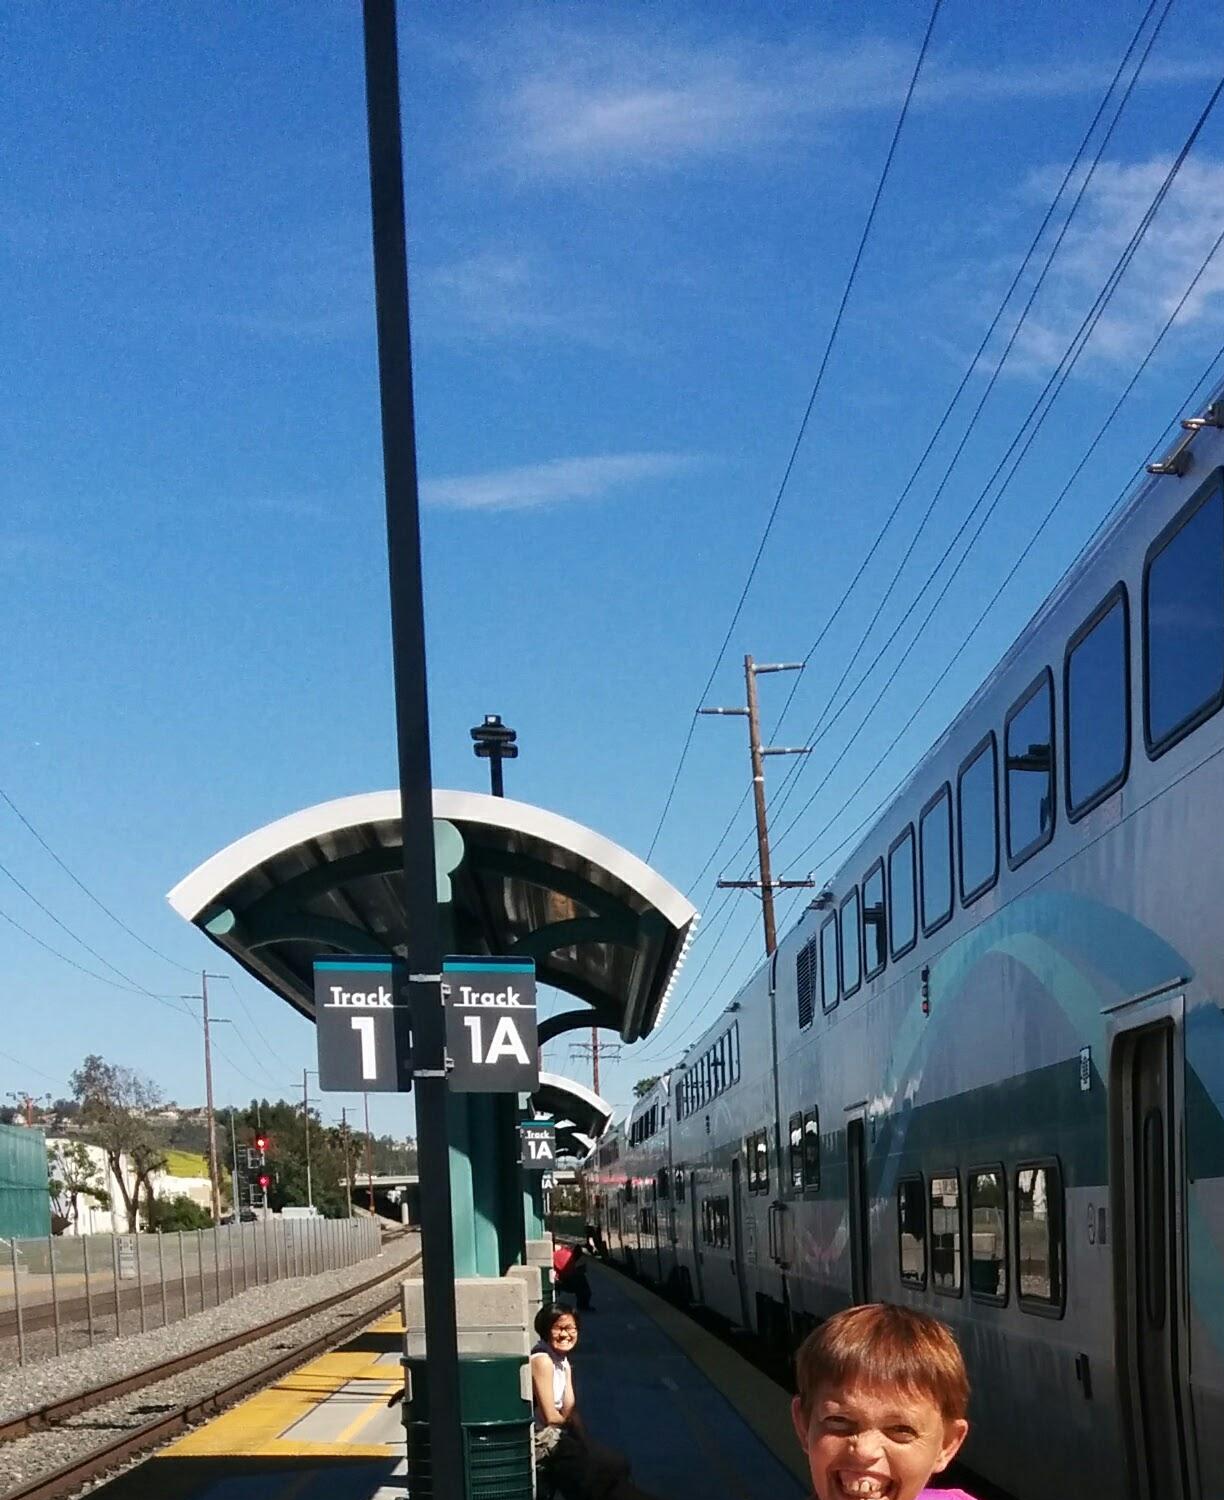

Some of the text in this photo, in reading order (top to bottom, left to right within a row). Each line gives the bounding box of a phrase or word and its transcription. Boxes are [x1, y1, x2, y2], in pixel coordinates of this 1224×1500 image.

[330, 986, 392, 1006] Track
[459, 986, 520, 1006] Track
[351, 1016, 377, 1080] 1
[463, 1016, 531, 1065] 1A
[526, 1130, 550, 1139] Track
[527, 1140, 553, 1160] 1A
